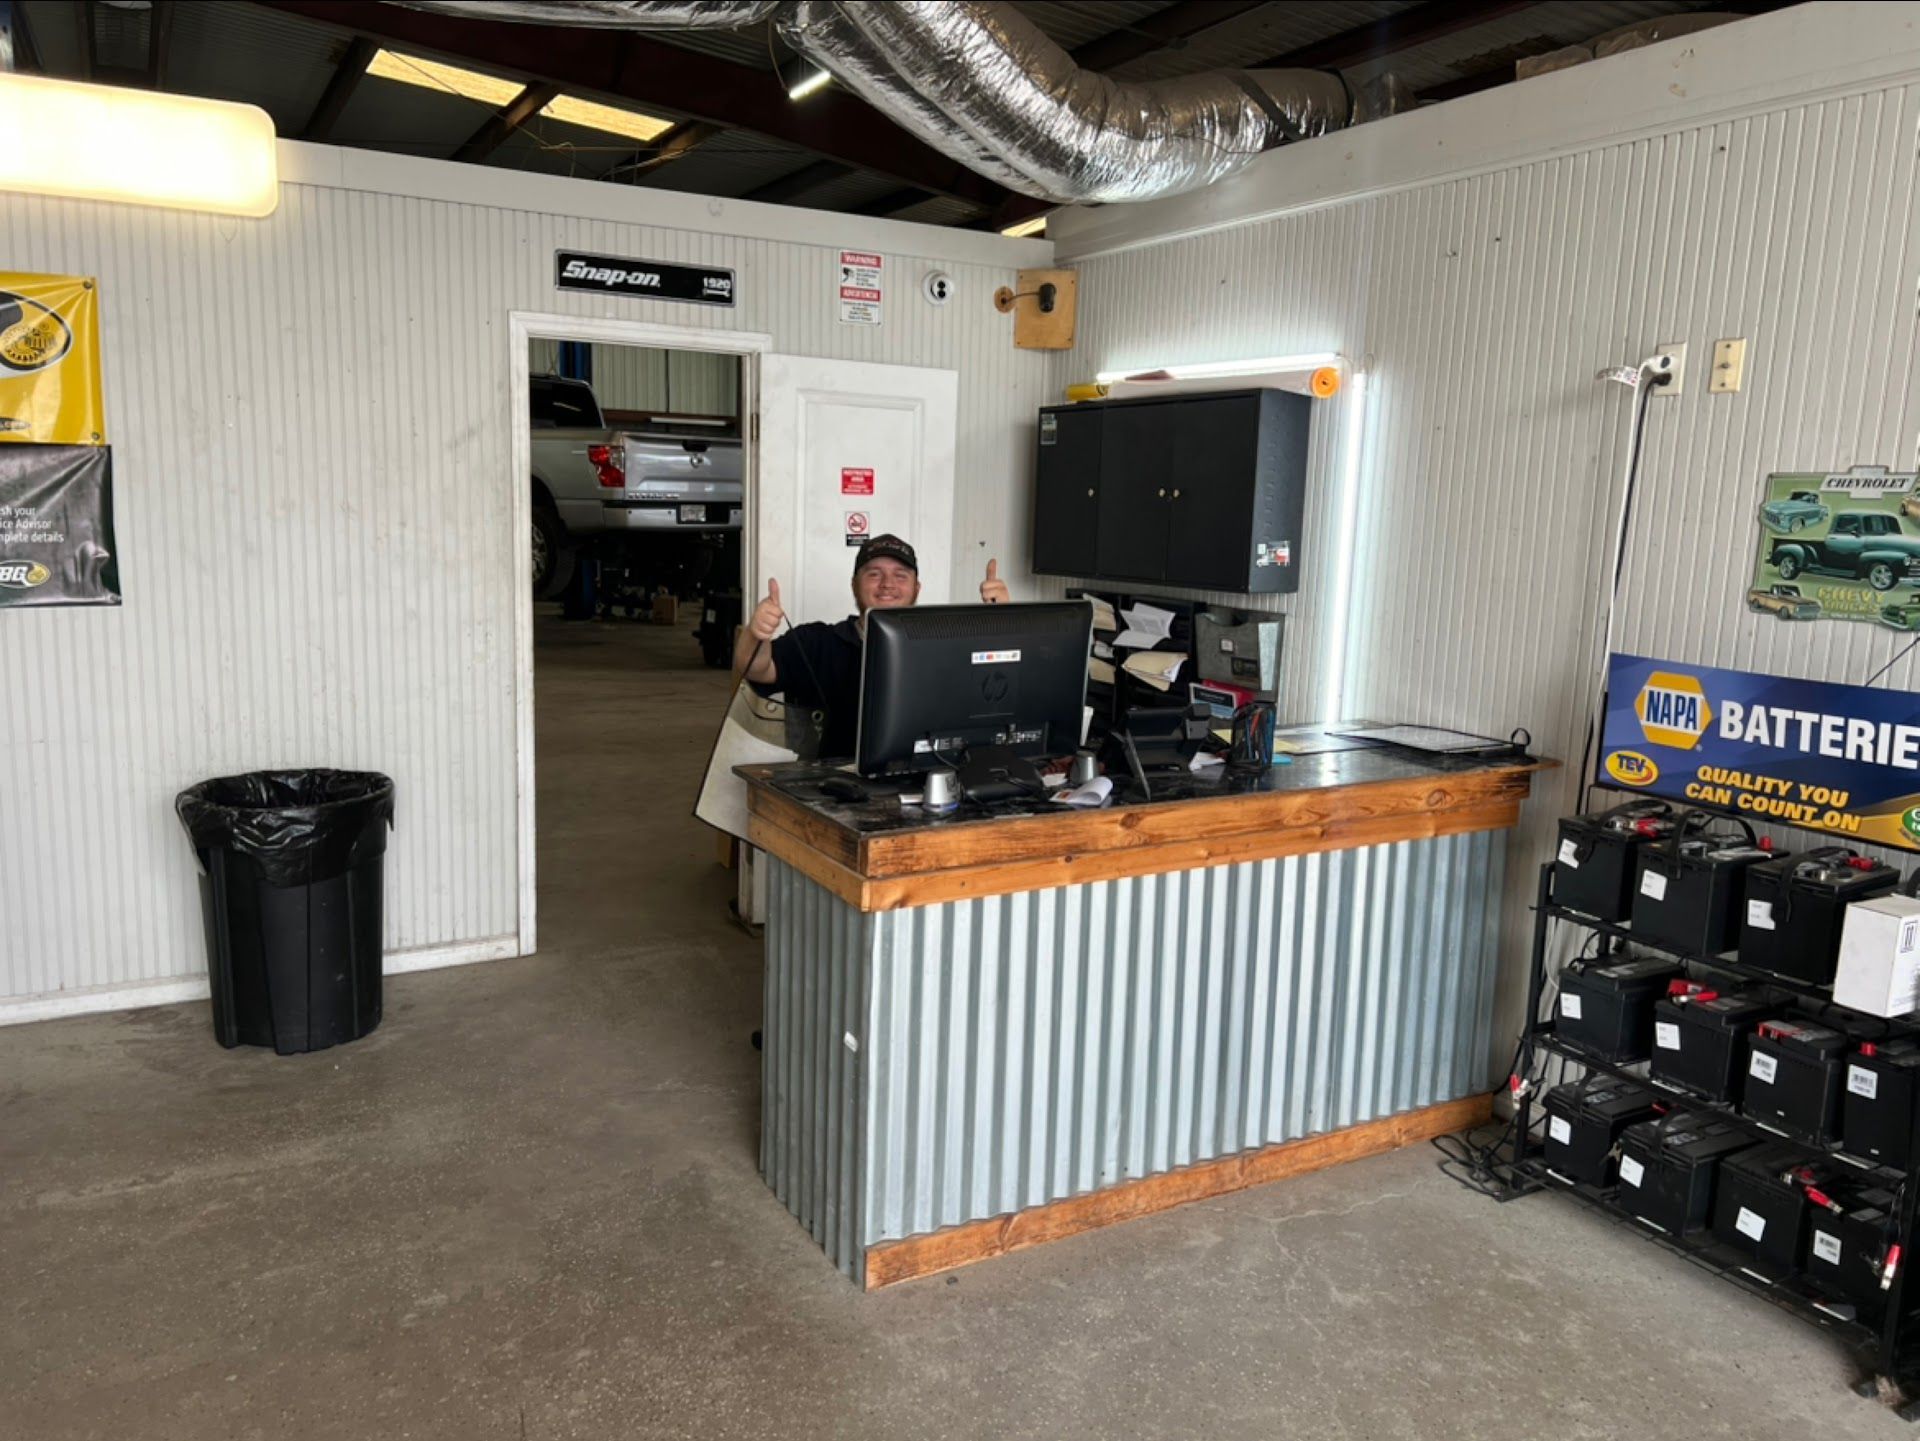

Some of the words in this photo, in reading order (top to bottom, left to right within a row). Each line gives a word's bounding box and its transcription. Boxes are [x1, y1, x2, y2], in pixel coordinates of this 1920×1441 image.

[563, 260, 659, 286] Snap-on
[1827, 478, 1909, 489] CHEVROLET
[15, 507, 36, 518] your
[16, 518, 52, 529] Advisor
[31, 531, 64, 543] details
[1818, 587, 1886, 603] CHEVY
[1646, 690, 1697, 731] NAPA
[1719, 700, 1920, 769] BATTERIE
[1697, 765, 1793, 797] QUALITY
[1800, 784, 1849, 808] YOU
[1685, 783, 1732, 805] CAN
[1737, 793, 1819, 822] COUNT
[1823, 810, 1862, 832] ON
